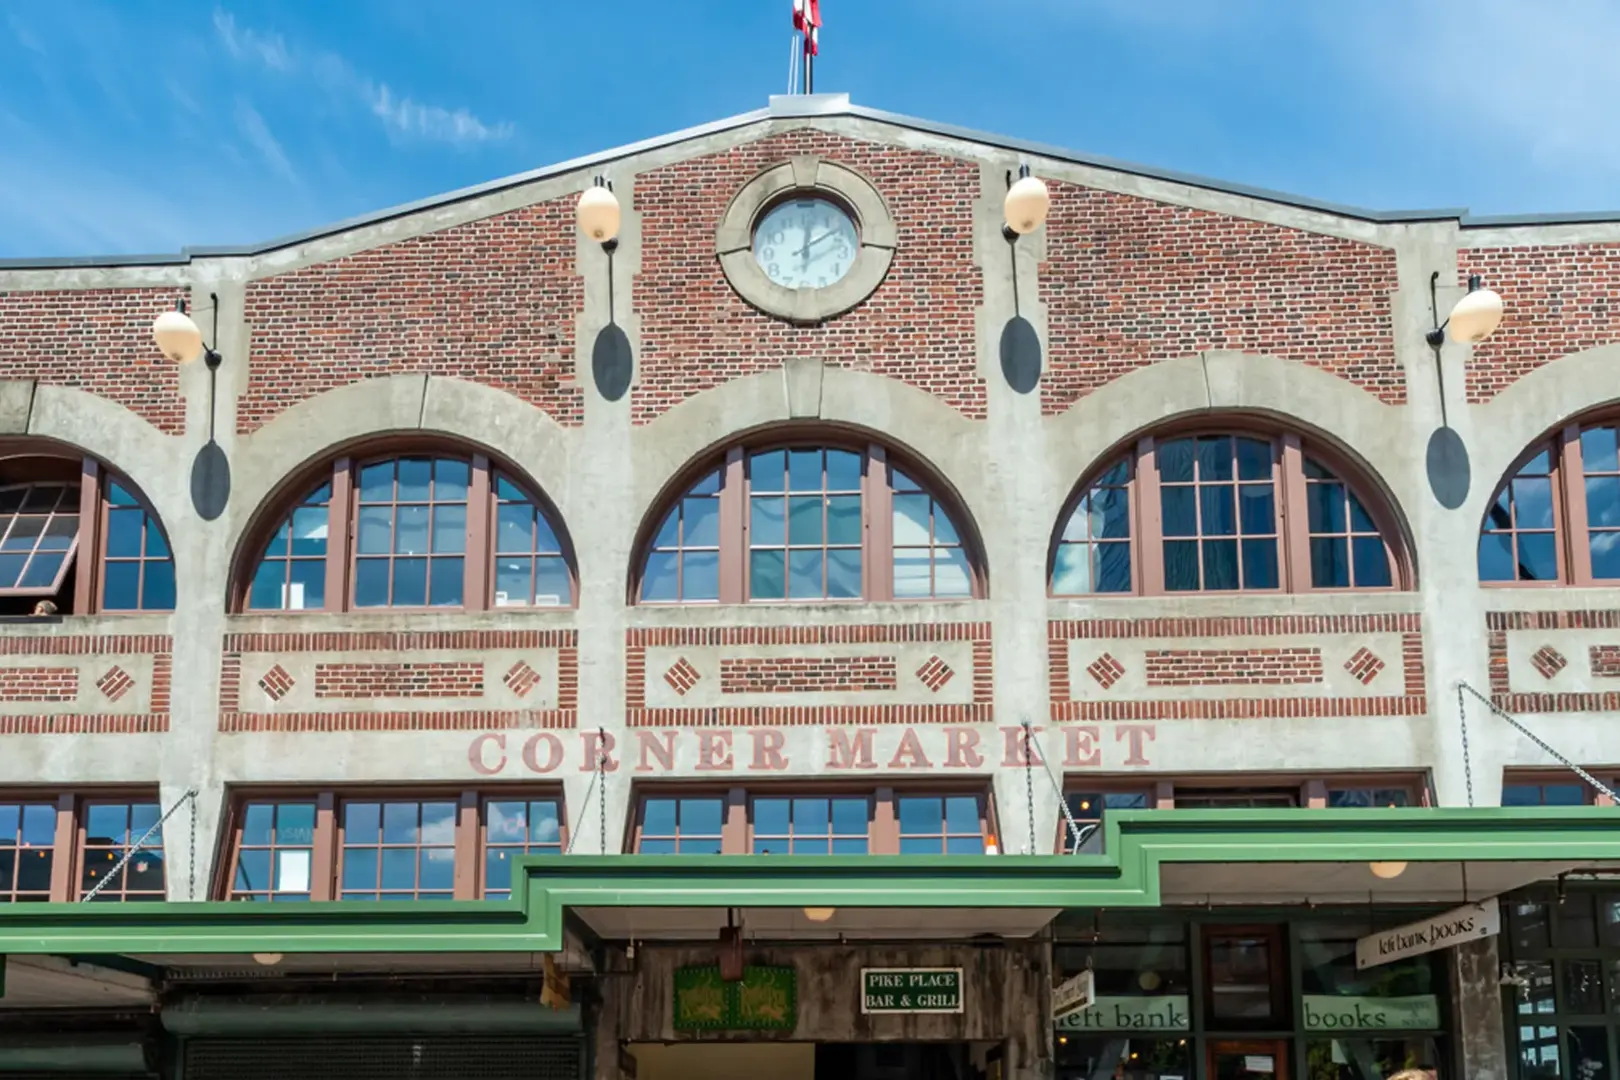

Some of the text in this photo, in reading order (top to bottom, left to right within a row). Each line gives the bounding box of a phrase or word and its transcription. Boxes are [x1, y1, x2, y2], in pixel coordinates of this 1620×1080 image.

[767, 231, 785, 244] 10
[763, 247, 774, 261] 9
[837, 245, 849, 259] 3
[768, 262, 780, 277] 8
[468, 724, 1156, 775] CORNER MARKET
[1397, 929, 1428, 950] bank
[1428, 917, 1475, 942] books
[869, 974, 955, 988] PIKE PLACE
[866, 994, 960, 1007] BAR & GRILL
[1114, 1003, 1187, 1028] bank
[1303, 1002, 1387, 1028] books
